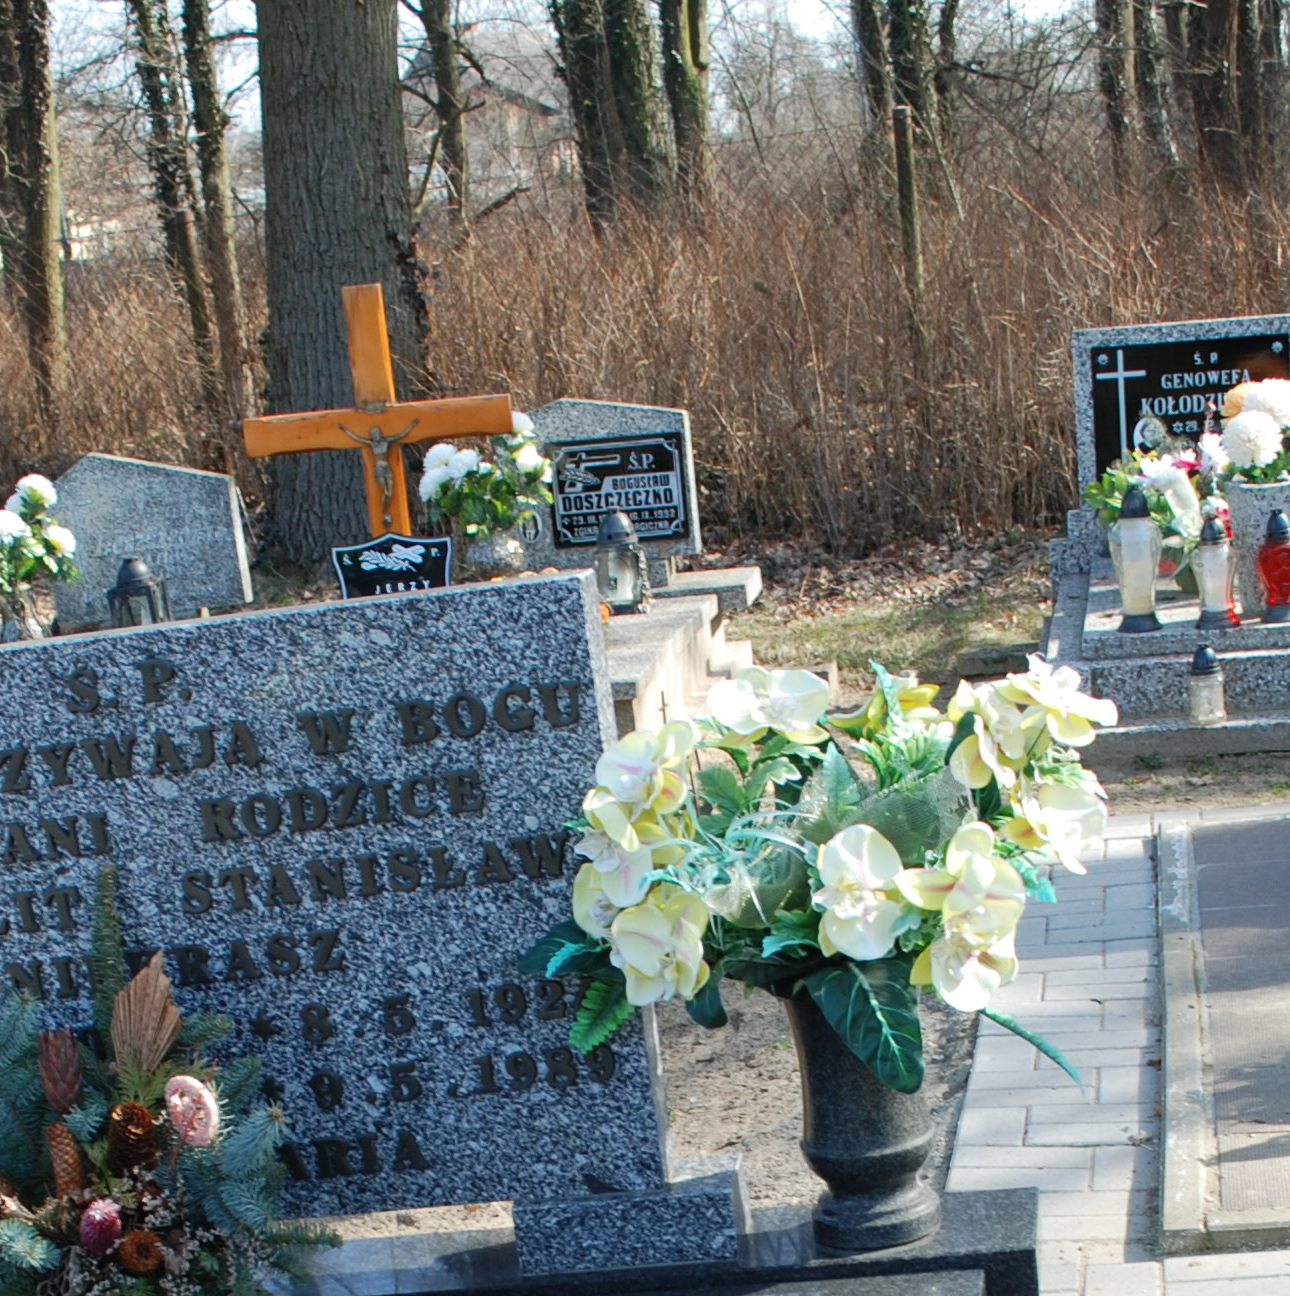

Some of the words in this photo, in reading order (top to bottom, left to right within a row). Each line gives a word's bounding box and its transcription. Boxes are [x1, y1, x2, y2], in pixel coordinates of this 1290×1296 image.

[1161, 368, 1251, 390] GENOWEFA
[612, 474, 670, 490] BOGUSŁAW
[297, 706, 355, 756] W
[397, 680, 581, 746] BOGU
[203, 769, 486, 844] RODZICE
